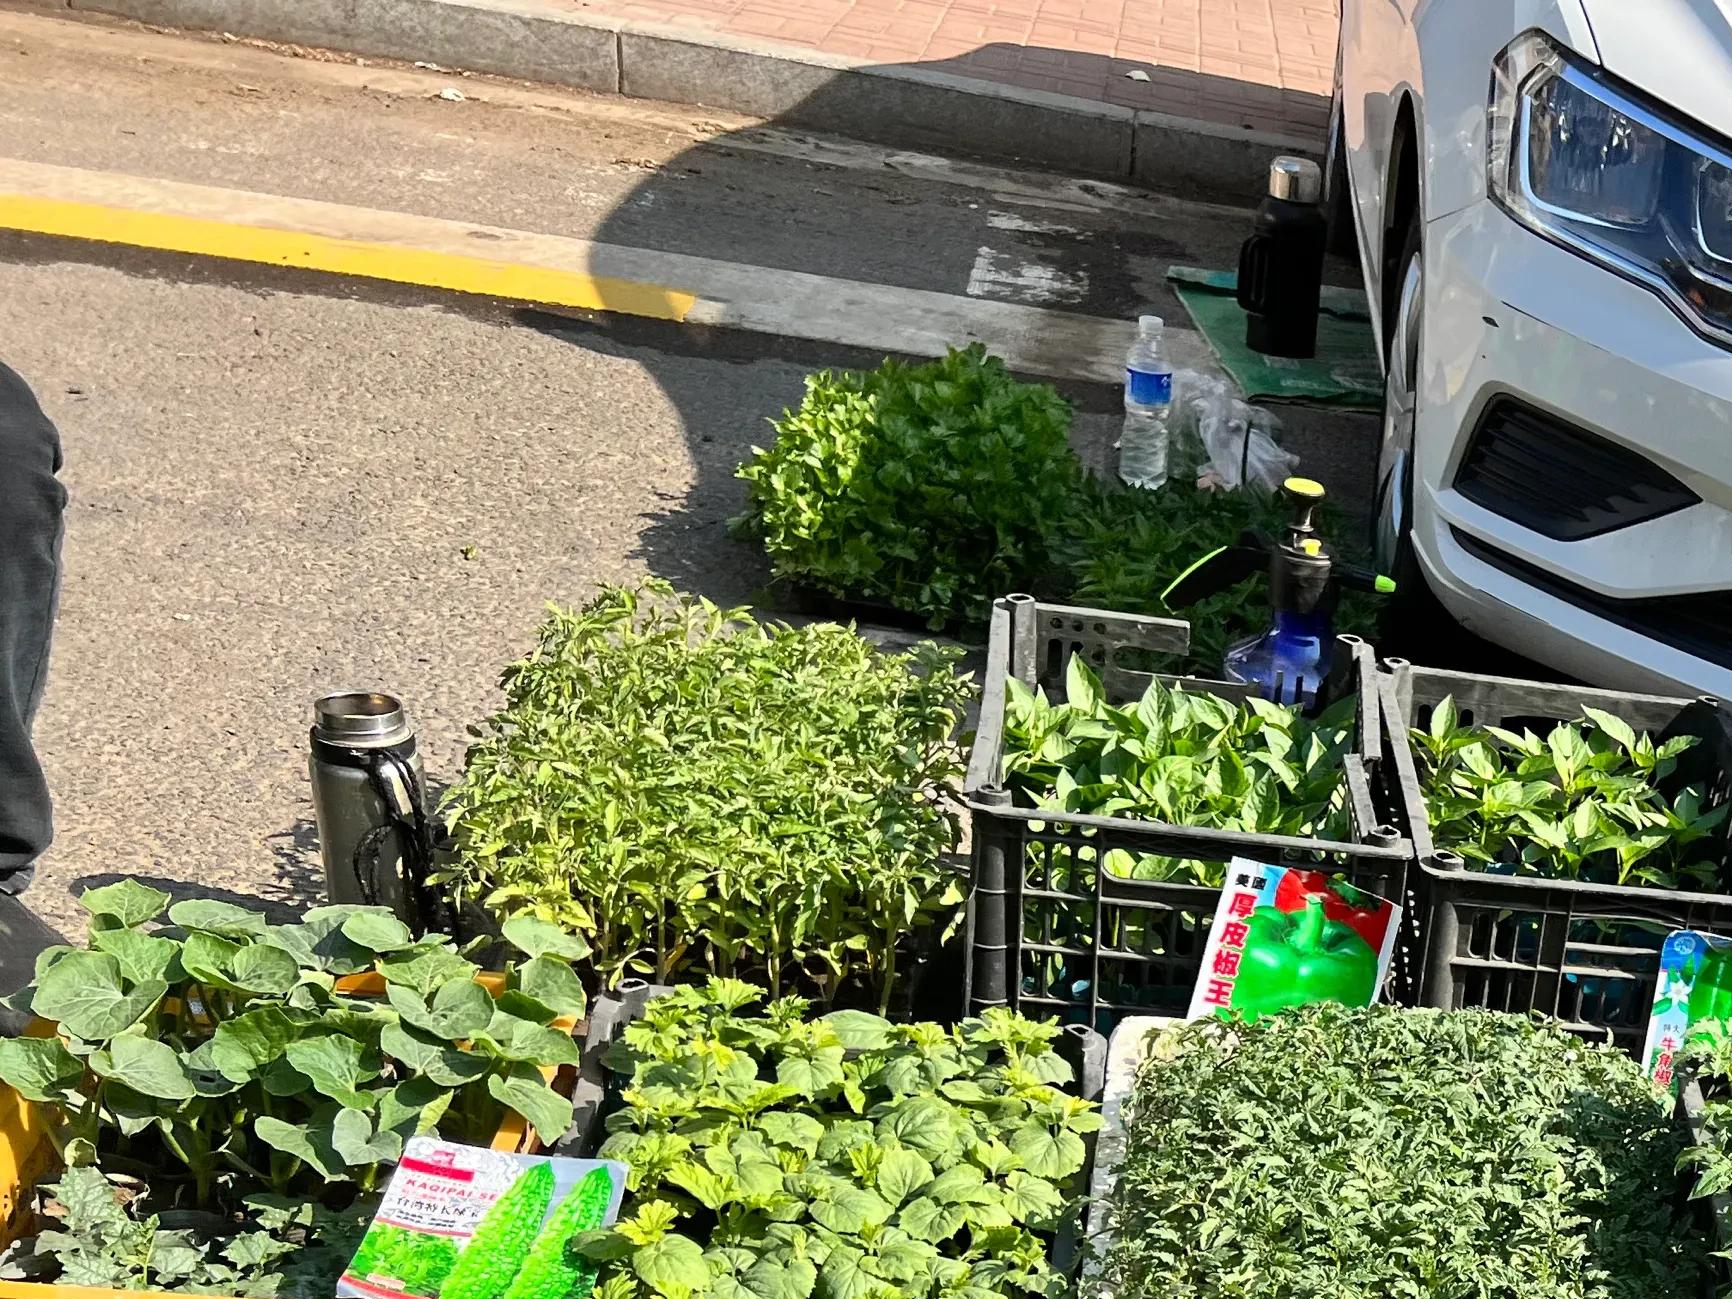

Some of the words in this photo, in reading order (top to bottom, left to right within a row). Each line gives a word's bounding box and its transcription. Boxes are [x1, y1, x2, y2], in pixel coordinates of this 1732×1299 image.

[1235, 873, 1267, 890] 美國
[1203, 893, 1258, 1008] 厚皮椒王
